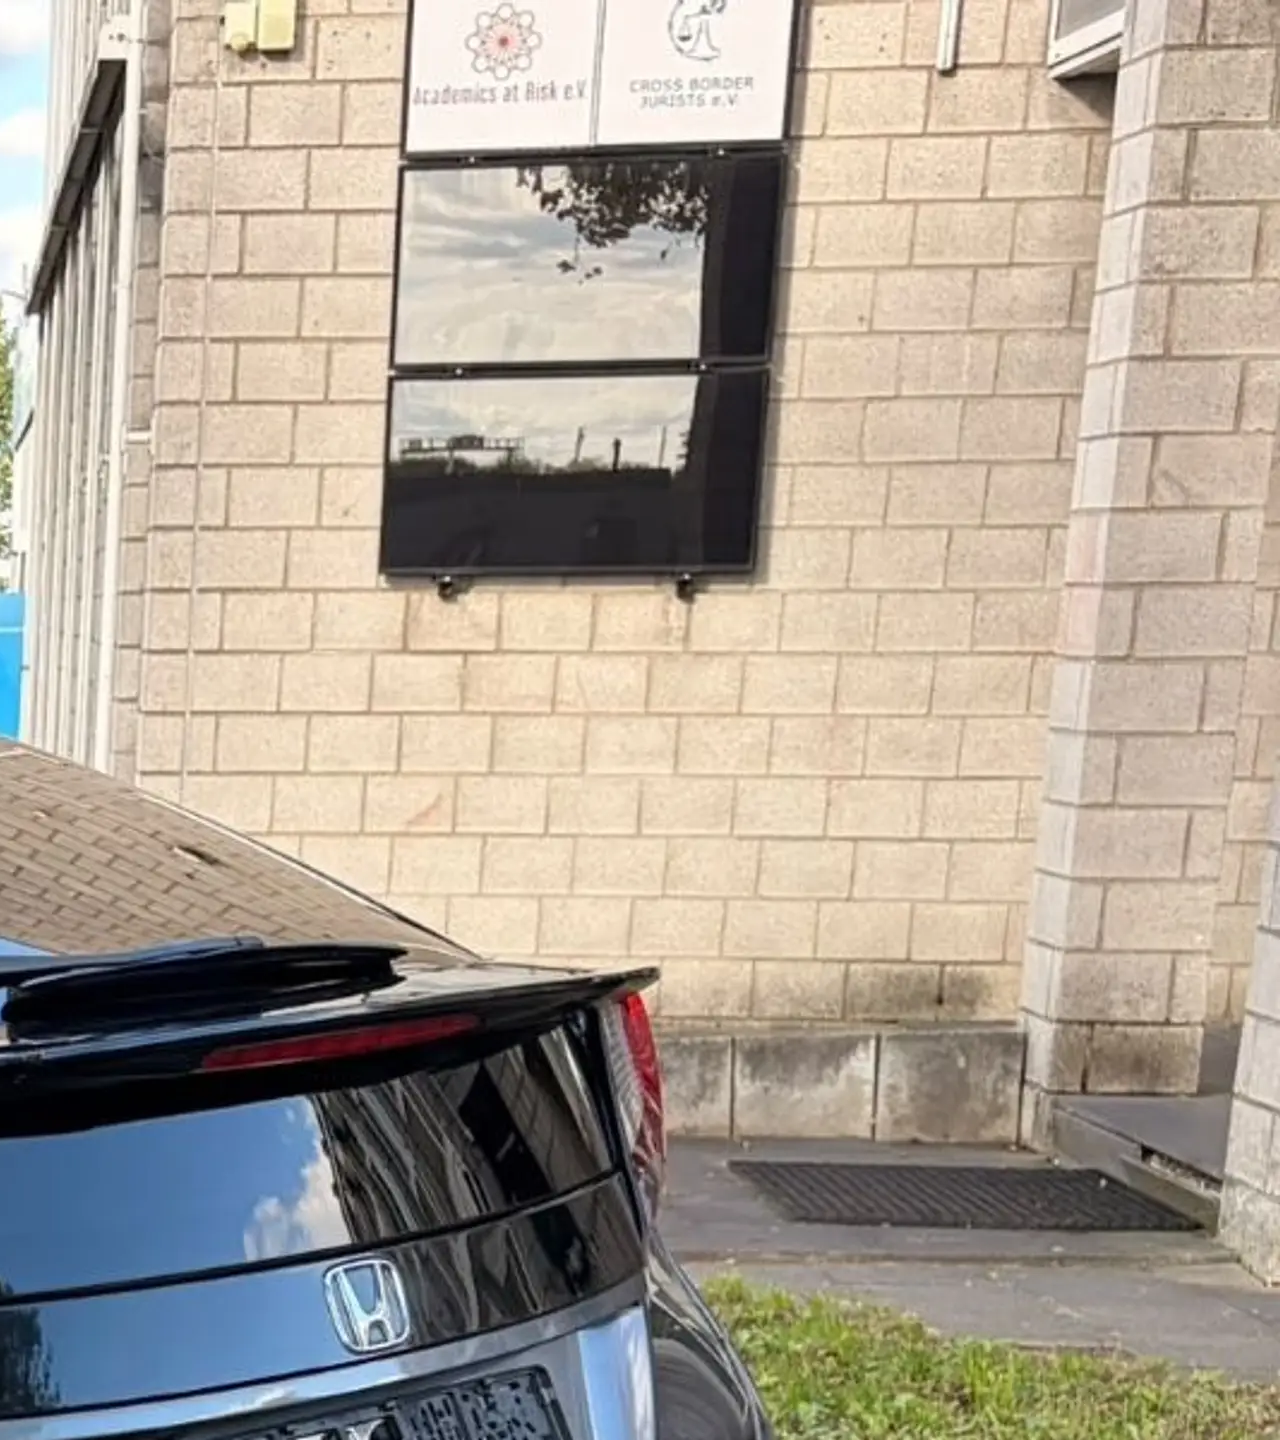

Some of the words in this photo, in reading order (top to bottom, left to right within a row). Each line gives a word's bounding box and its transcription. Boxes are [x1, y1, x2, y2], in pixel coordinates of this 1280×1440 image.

[412, 83, 497, 106] Academics
[502, 83, 519, 103] at
[525, 79, 557, 102] Risk
[629, 77, 683, 93] CROSS
[689, 76, 754, 91] BORDER
[639, 93, 706, 109] JURISTS
